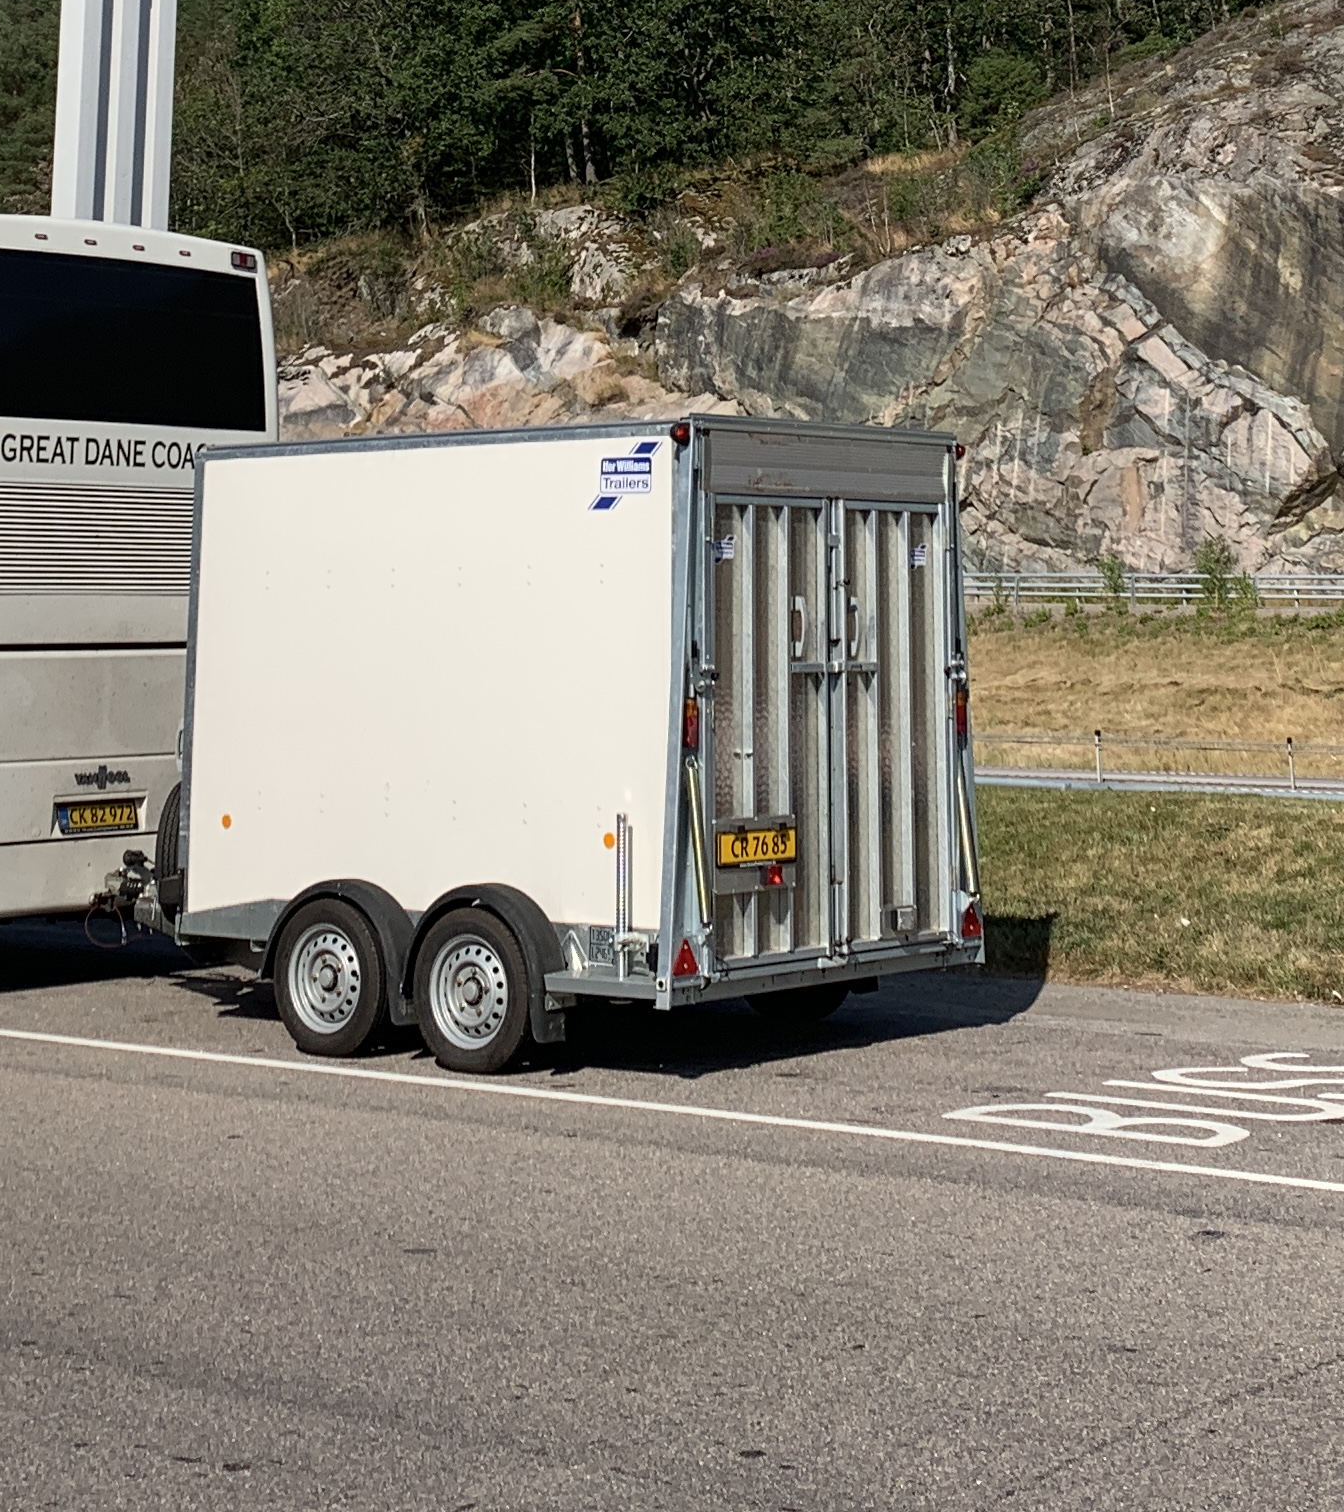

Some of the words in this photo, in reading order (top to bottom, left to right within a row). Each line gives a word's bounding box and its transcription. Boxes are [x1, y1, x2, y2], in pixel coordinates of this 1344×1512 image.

[0, 433, 80, 464] GREAT
[84, 438, 146, 468] DANE
[151, 441, 206, 470] COA
[616, 459, 650, 472] Williams
[603, 477, 649, 489] Trailers
[69, 807, 88, 825] CK
[90, 806, 107, 824] 82
[109, 804, 134, 823] 972
[731, 836, 749, 858] CR
